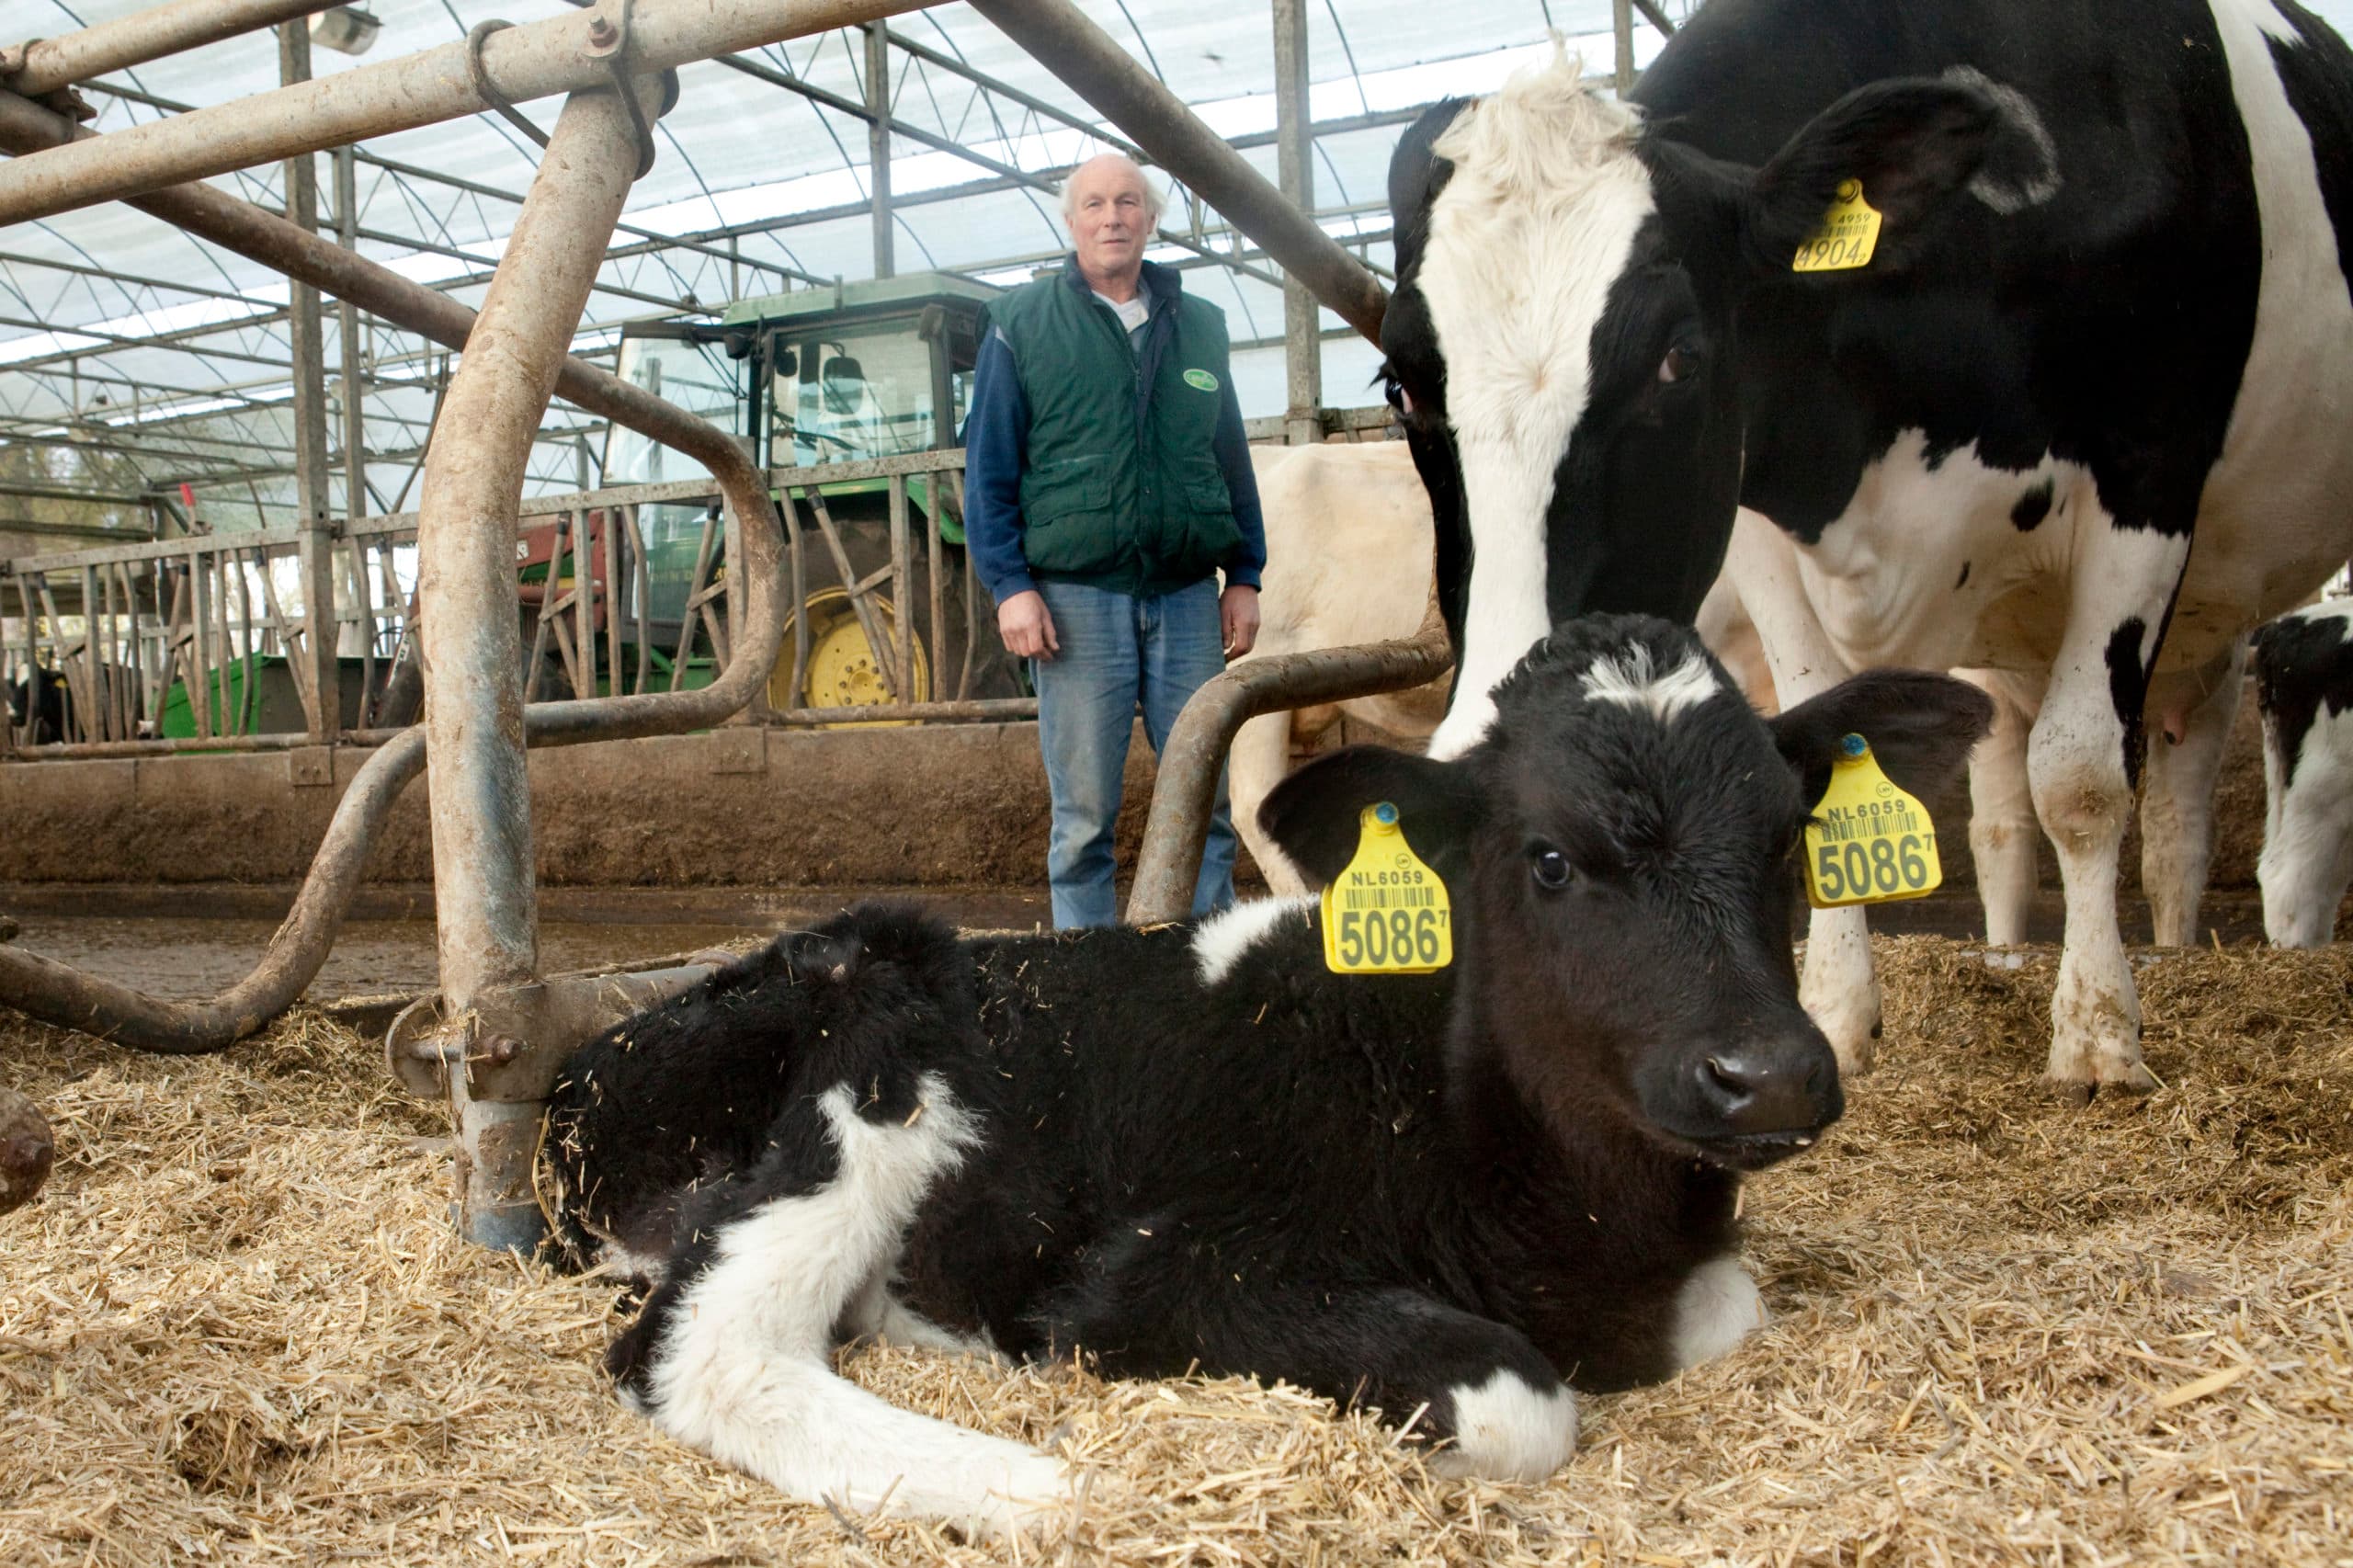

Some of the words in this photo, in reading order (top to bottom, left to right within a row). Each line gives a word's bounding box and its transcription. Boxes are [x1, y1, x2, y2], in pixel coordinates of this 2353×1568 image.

[1796, 237, 1862, 267] 4904
[1828, 799, 1905, 822] NL6059
[1351, 870, 1423, 886] NL6059
